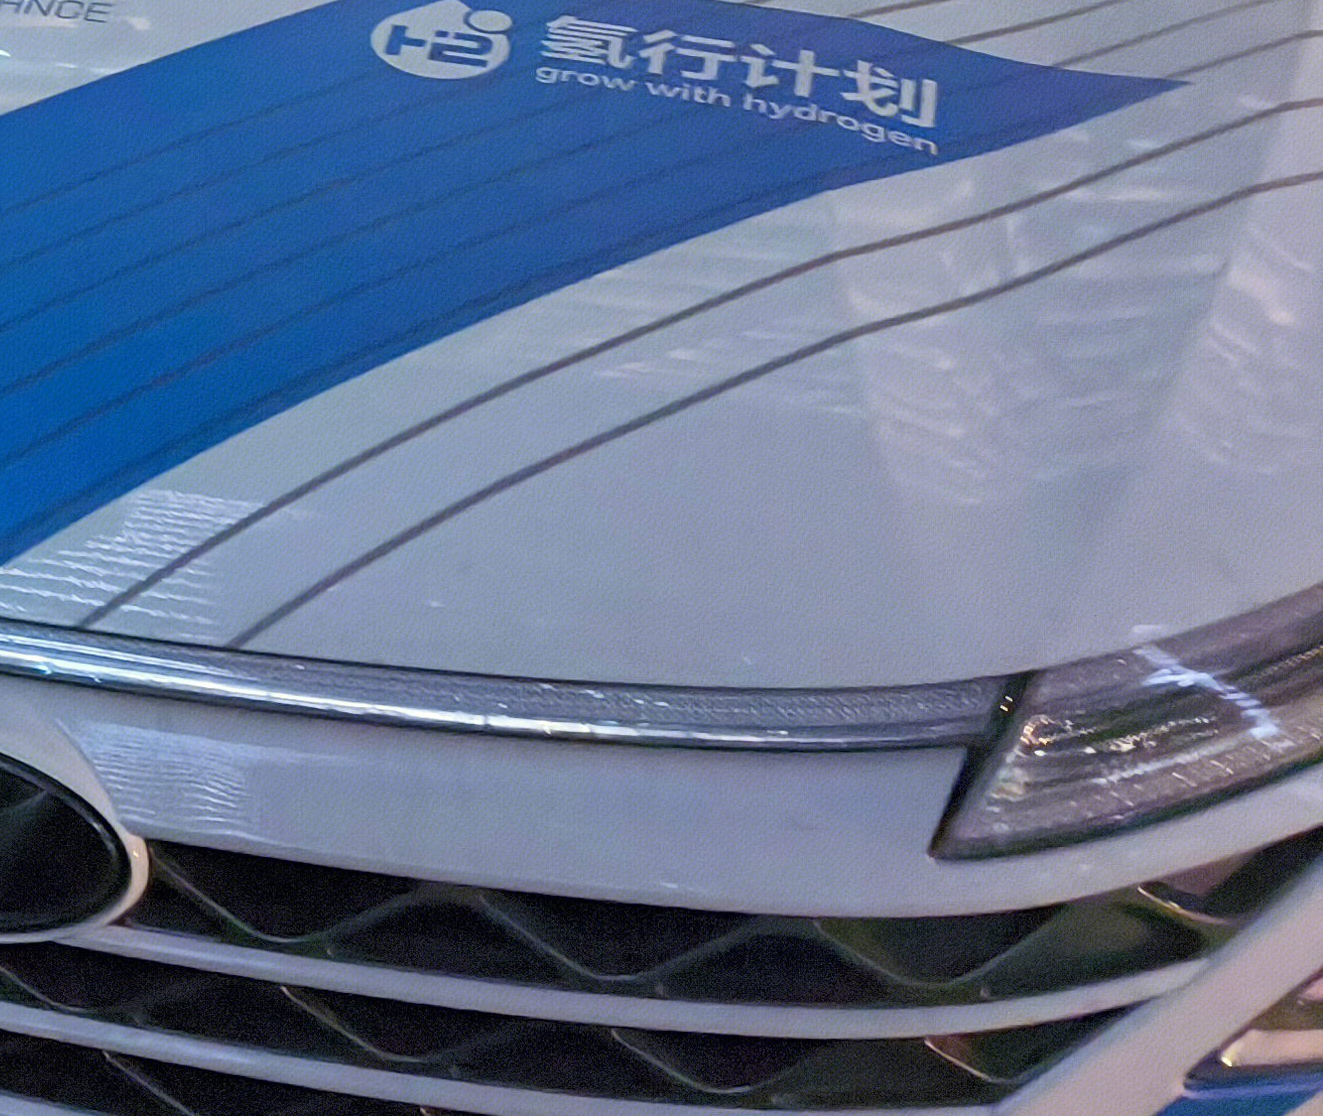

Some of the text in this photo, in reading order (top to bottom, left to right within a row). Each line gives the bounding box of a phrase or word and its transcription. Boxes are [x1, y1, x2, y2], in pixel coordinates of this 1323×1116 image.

[535, 64, 939, 156] grow with hydrogen
[540, 15, 938, 128] 氢行计划
